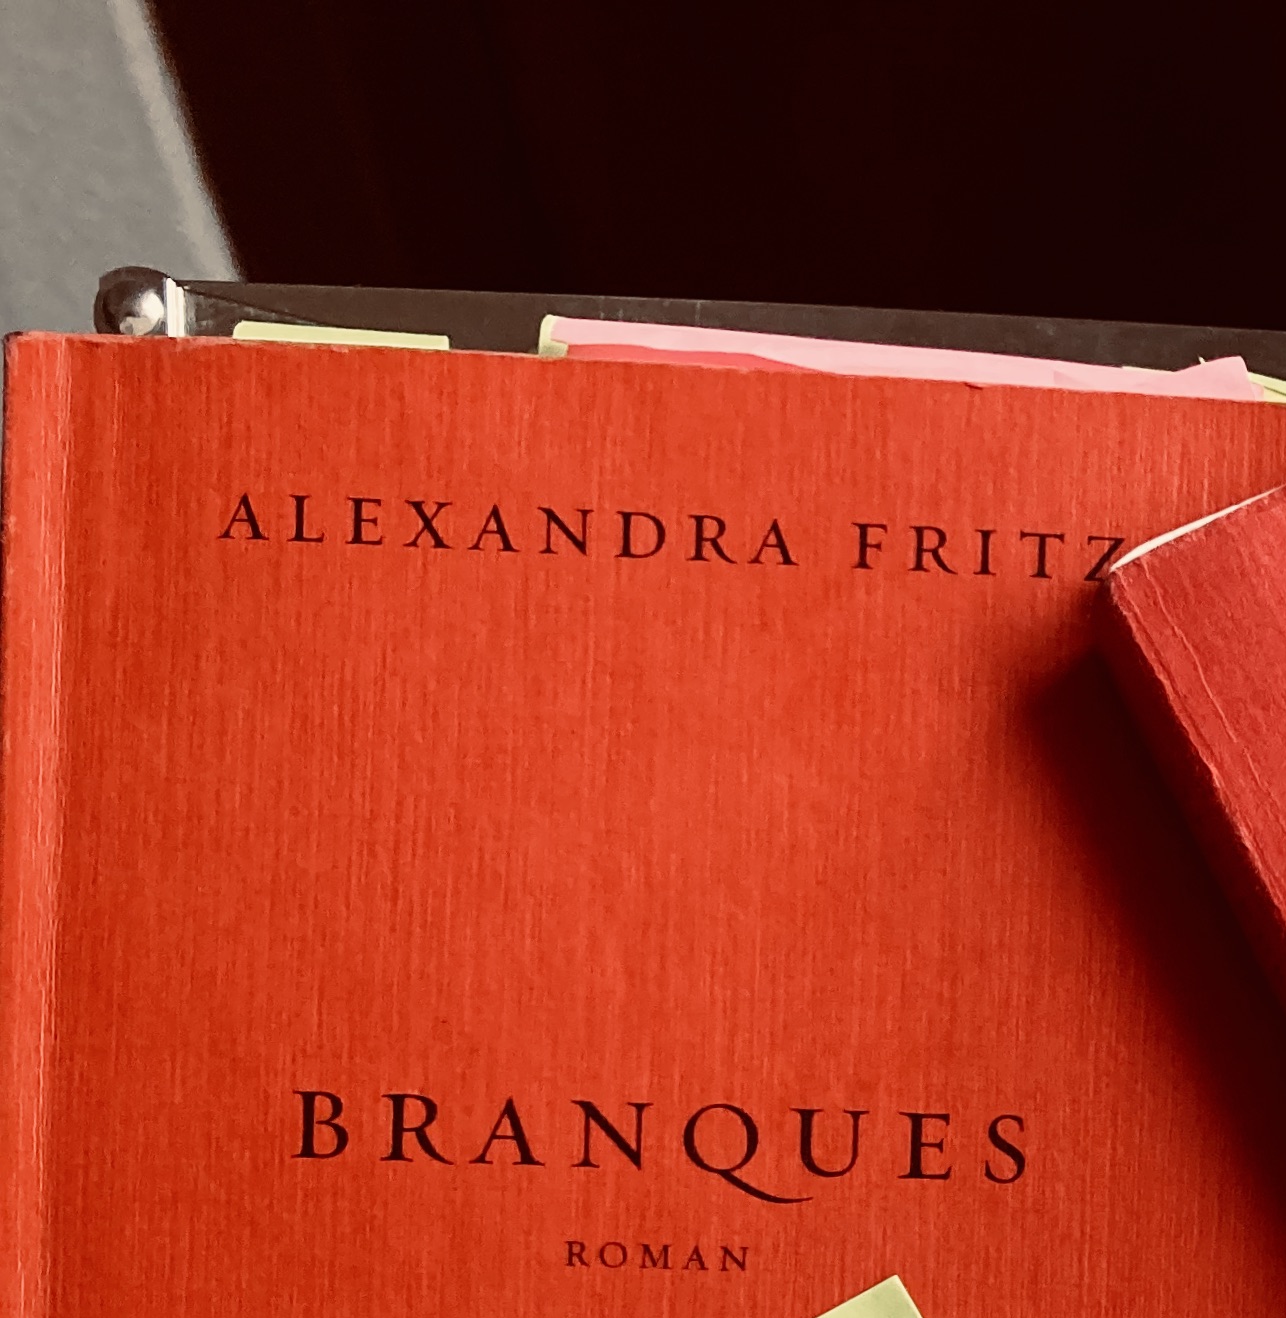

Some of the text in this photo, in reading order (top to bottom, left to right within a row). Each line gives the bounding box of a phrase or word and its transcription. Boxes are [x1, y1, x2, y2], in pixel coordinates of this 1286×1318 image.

[217, 494, 1129, 583] ALEXANDRA FRITZ
[291, 1088, 1030, 1203] BRANQUES
[564, 1239, 751, 1272] ROMAN
